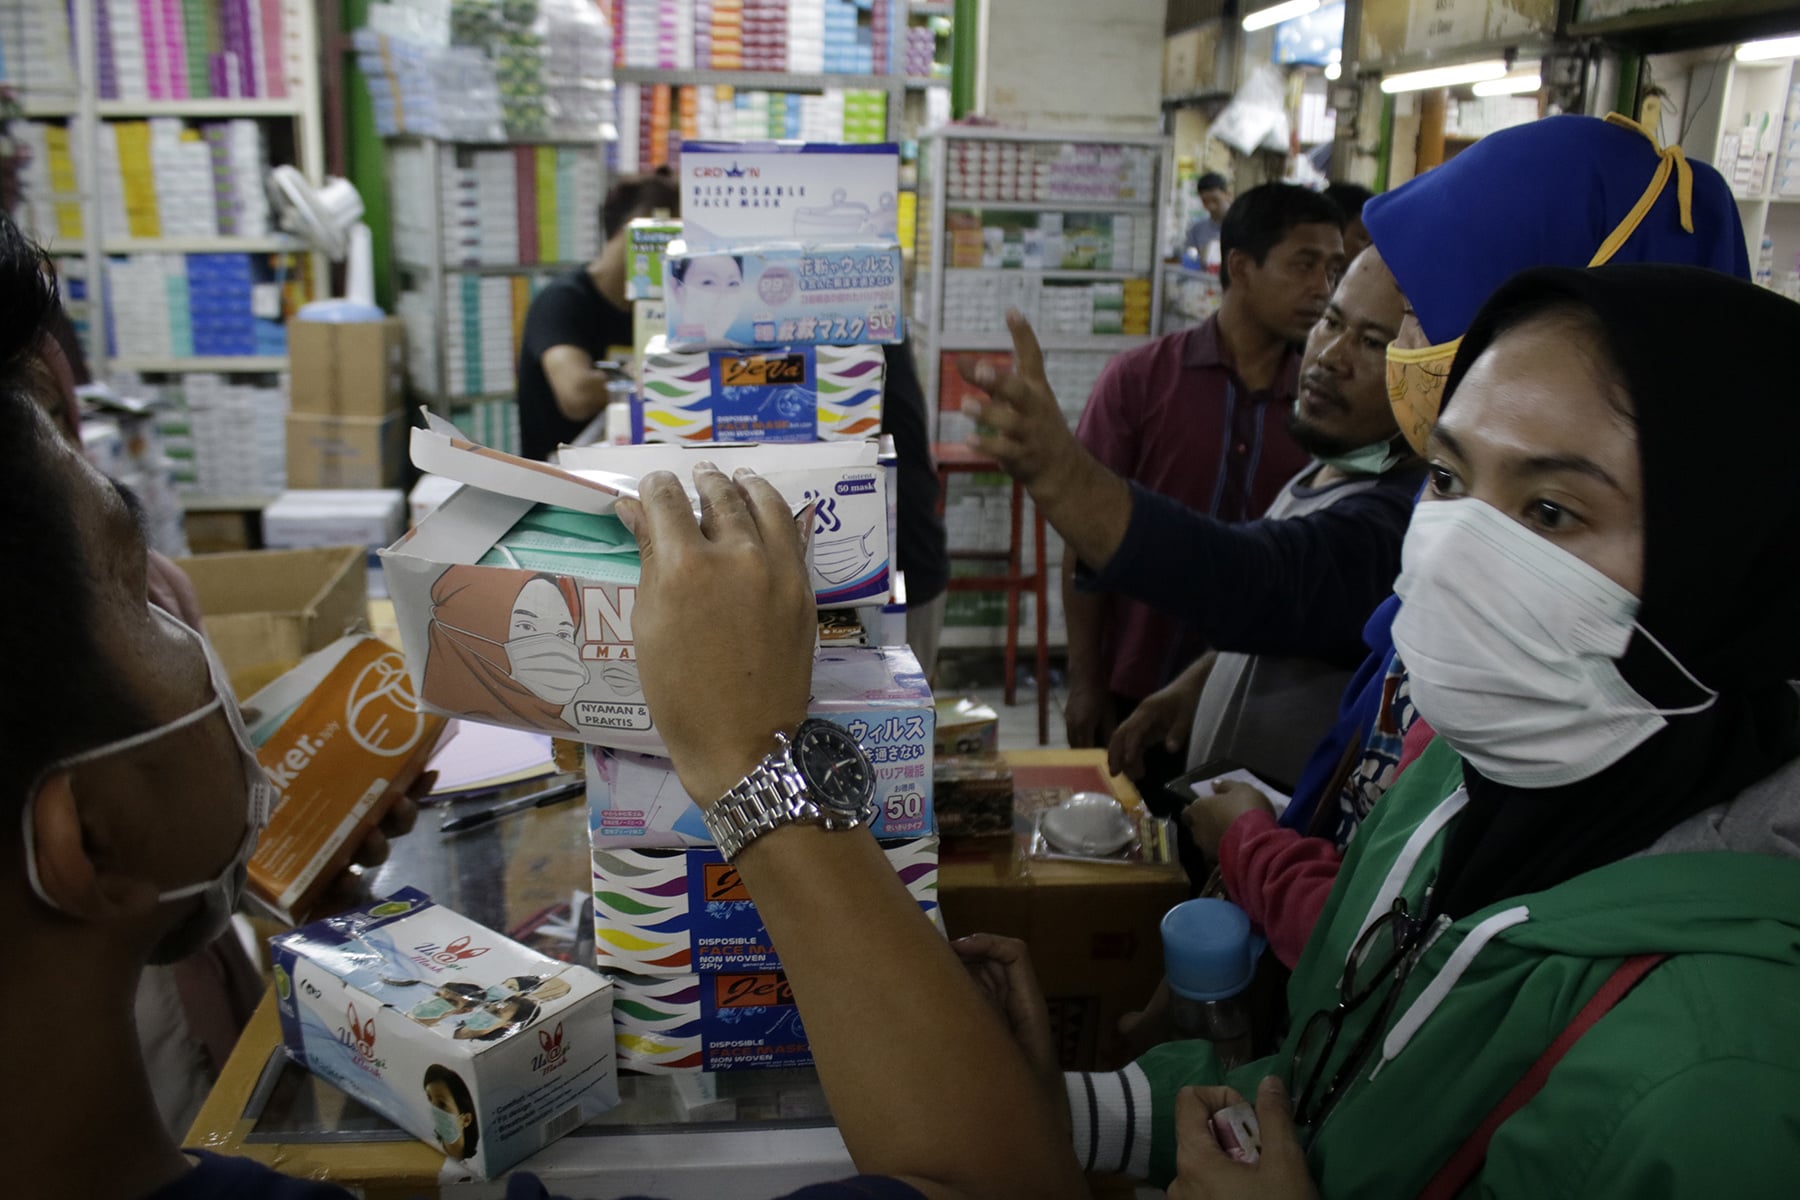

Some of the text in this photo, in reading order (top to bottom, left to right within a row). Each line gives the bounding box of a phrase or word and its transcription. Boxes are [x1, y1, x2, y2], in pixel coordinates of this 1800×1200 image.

[694, 185, 806, 197] DISPOSABLE
[694, 198, 780, 208] FACE MASK
[869, 313, 893, 331] 50
[837, 483, 874, 493] 50 mask
[582, 586, 637, 643] N
[596, 646, 630, 659] MA
[581, 704, 647, 716] NYAMAN &
[585, 716, 633, 727] PRAKTIS
[848, 715, 926, 744] ウィルス
[262, 733, 324, 793] ker.
[887, 792, 921, 820] 50
[698, 937, 757, 946] DISPOSIBLE
[699, 944, 777, 955] FACE MA
[725, 954, 766, 963] WOVEN
[700, 962, 723, 970] 2Ply
[722, 976, 796, 1005] JeV
[709, 1039, 765, 1049] DISPOSIBLE
[710, 1044, 807, 1057] FACE MASK
[734, 1054, 773, 1063] WOVEN
